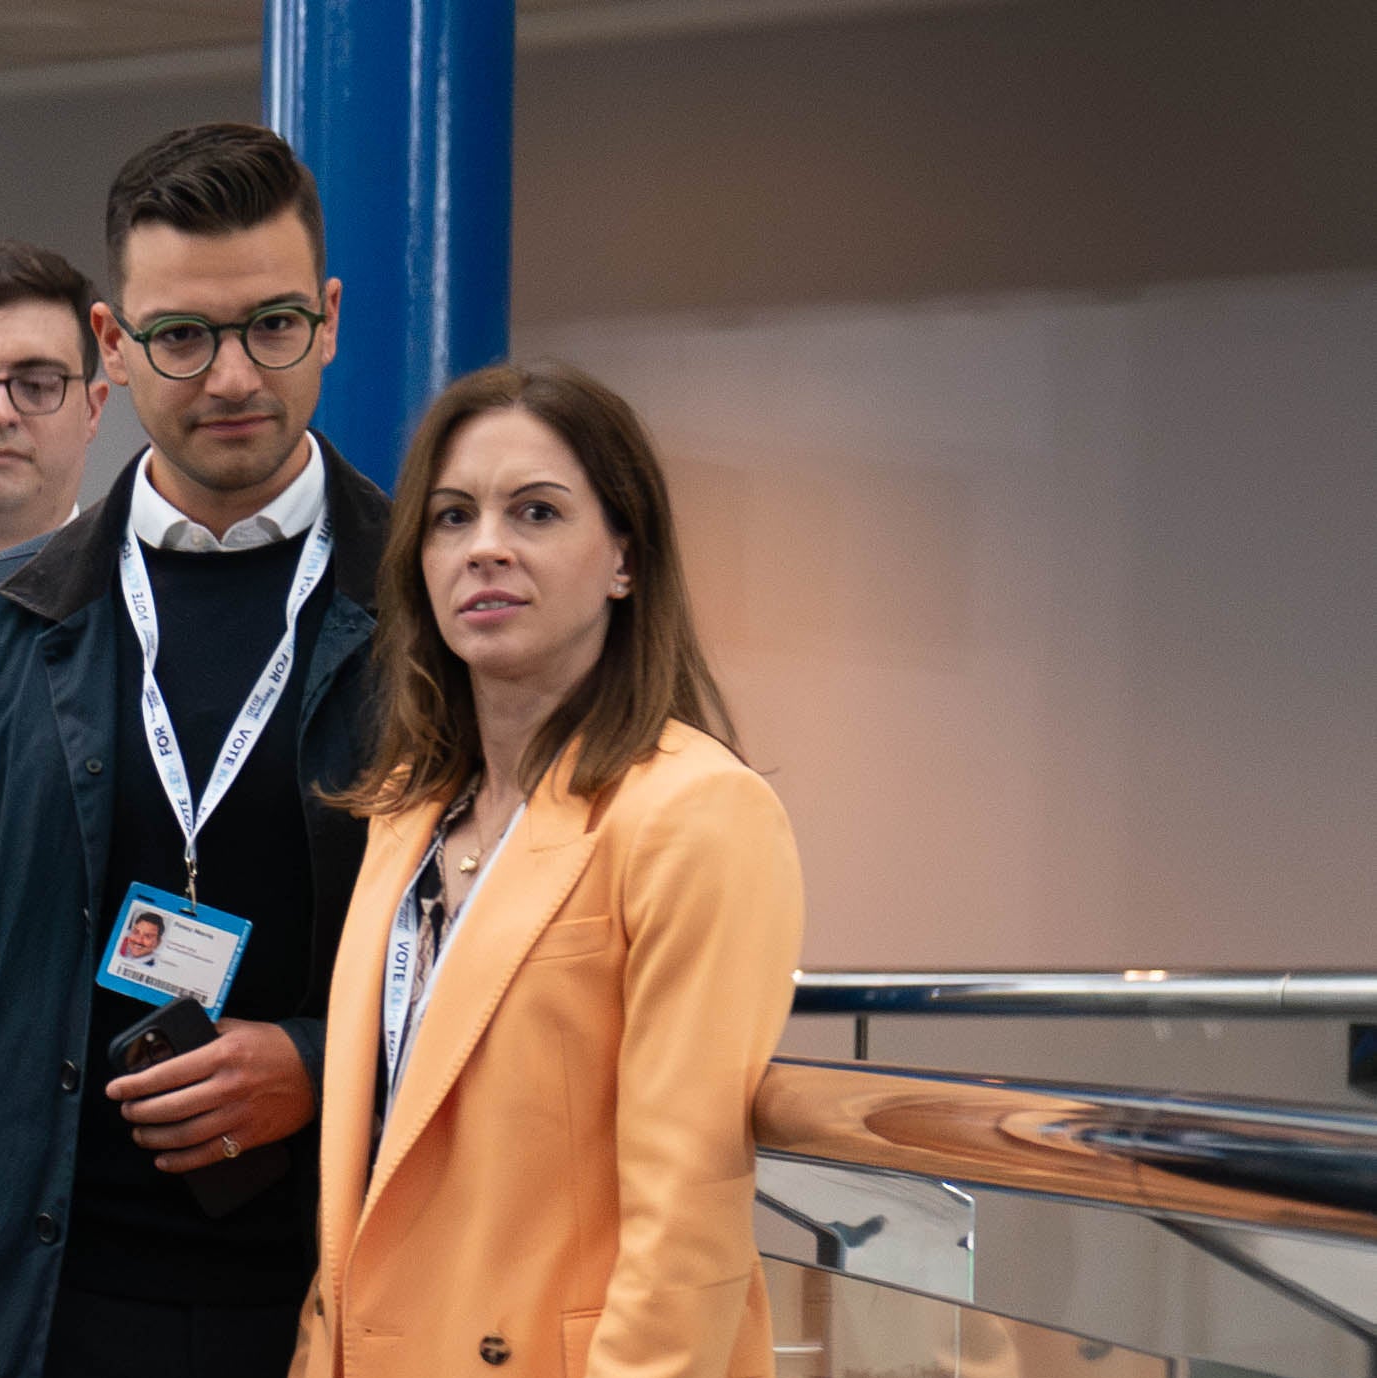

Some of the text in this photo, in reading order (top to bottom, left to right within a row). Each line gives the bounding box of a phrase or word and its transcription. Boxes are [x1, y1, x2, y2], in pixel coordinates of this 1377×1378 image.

[132, 592, 149, 621] VOTE
[268, 653, 290, 684] FOR
[154, 725, 172, 757] FOR
[223, 729, 252, 766] VOTE
[393, 941, 410, 982] VOTE
